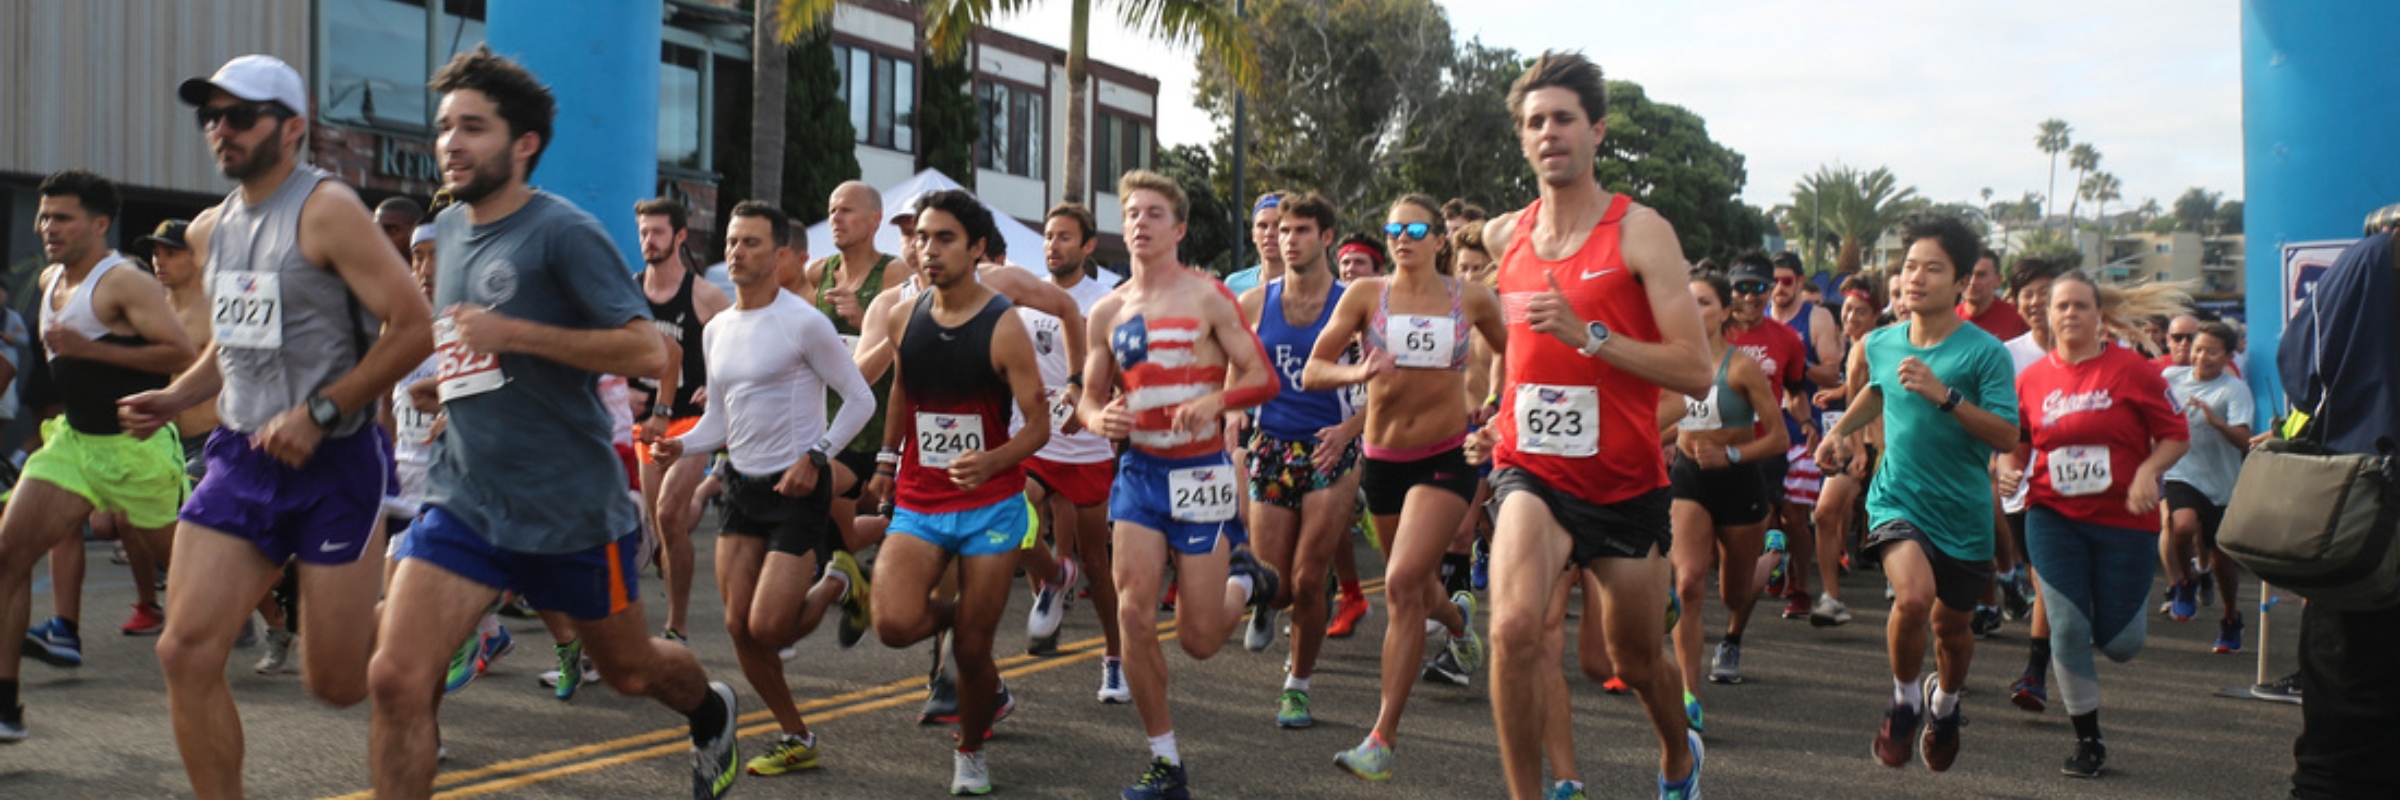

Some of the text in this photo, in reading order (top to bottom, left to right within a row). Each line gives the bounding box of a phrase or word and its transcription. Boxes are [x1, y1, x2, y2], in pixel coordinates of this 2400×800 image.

[215, 297, 276, 326] 2027
[1406, 331, 1435, 352] 65
[1528, 409, 1583, 436] 623
[921, 431, 980, 454] 2240
[2056, 459, 2106, 483] 1576
[1176, 483, 1233, 509] 2416
